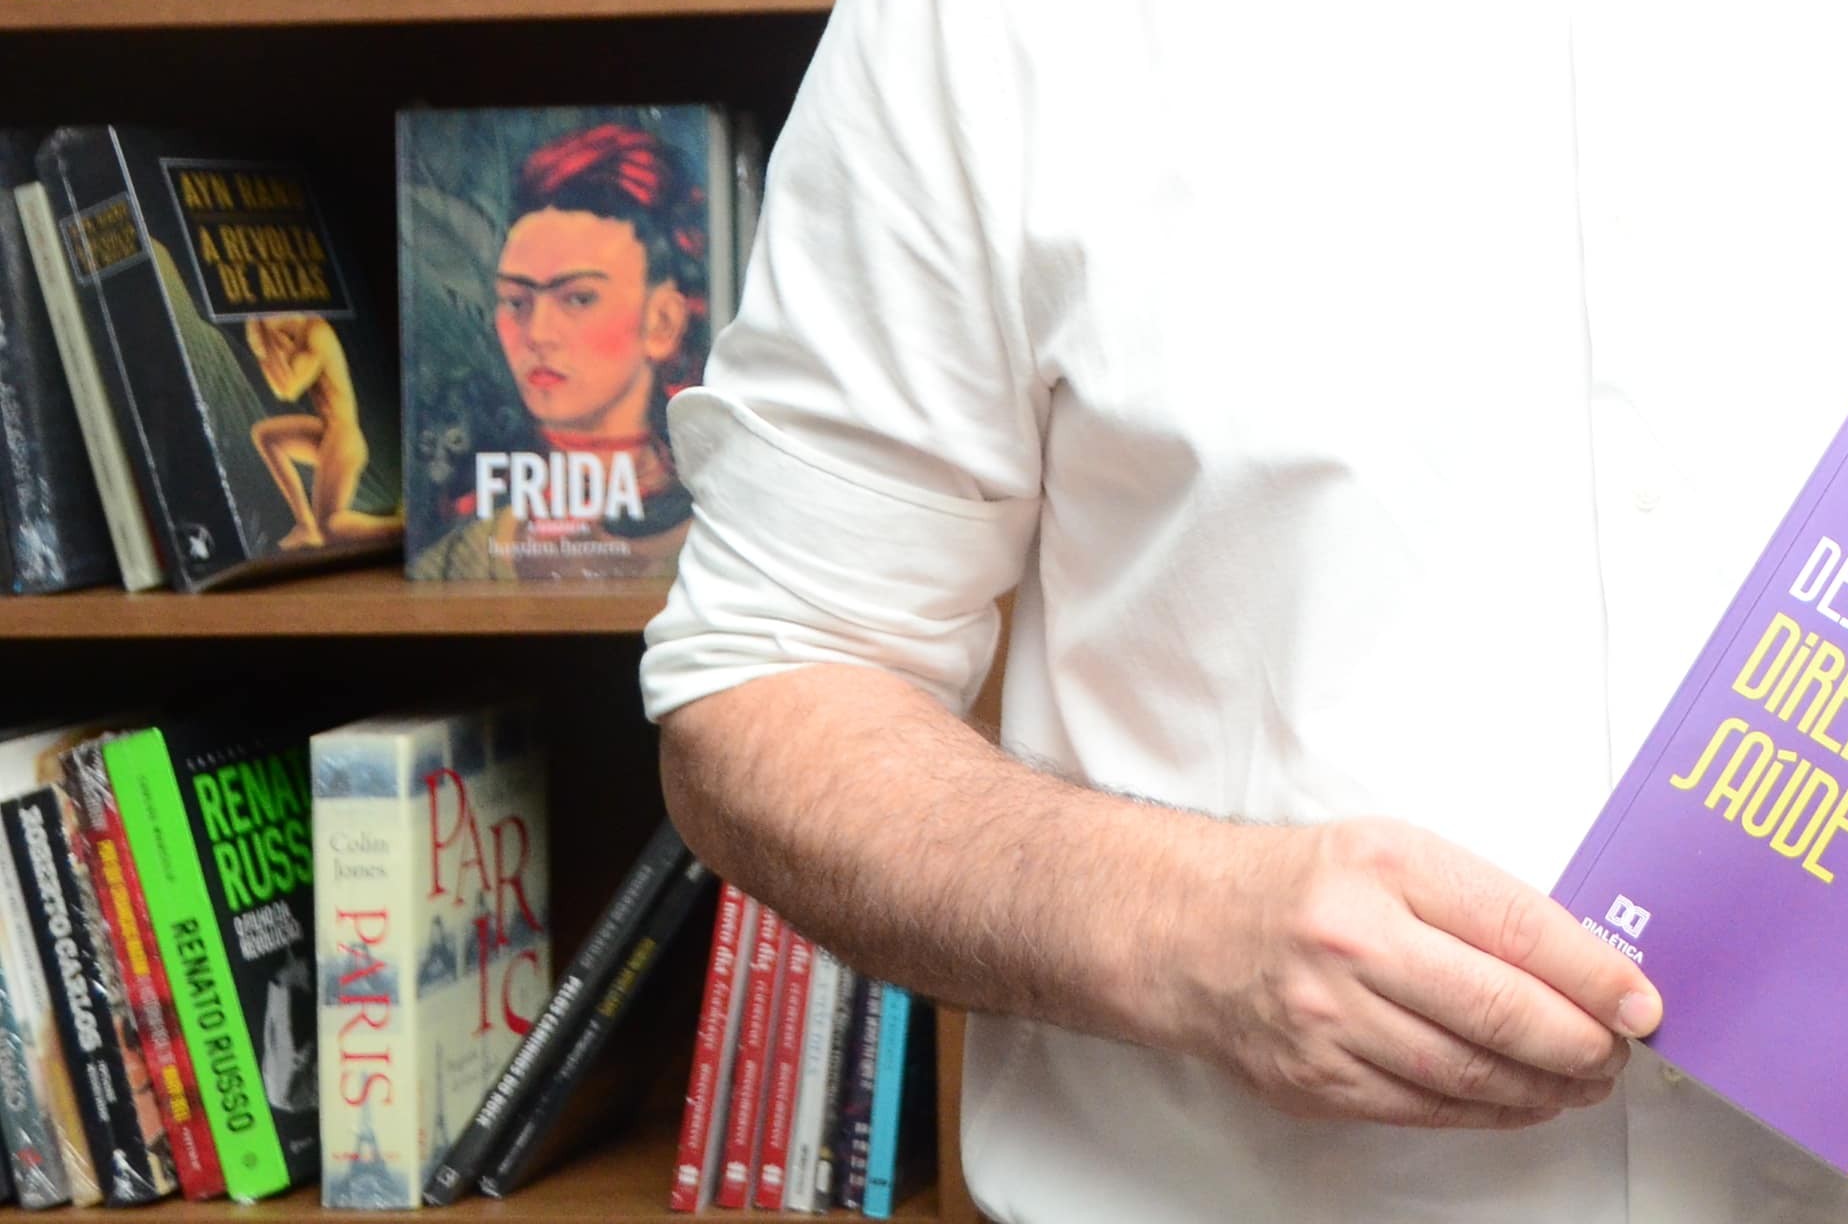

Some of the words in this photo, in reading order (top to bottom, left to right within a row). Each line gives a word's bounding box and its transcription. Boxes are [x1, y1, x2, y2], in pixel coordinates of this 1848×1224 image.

[180, 170, 235, 210] AYN
[199, 225, 222, 267] A
[220, 224, 329, 265] REVOLTA
[217, 262, 257, 305] DE
[257, 262, 333, 303] ATLAS
[475, 451, 645, 522] FRIDA
[212, 819, 314, 913] RUSS
[329, 831, 390, 856] Colin
[333, 857, 389, 880] Jones
[18, 806, 71, 936] ROBERTO
[52, 937, 102, 1052] CARLOS
[1581, 915, 1645, 965] DIALÉTICA
[335, 907, 393, 1109] PARIS
[545, 972, 585, 1017] PELOS
[170, 918, 226, 1032] RENATO
[205, 1034, 256, 1134] RUSSO
[501, 1009, 562, 1079] CAMINHOS
[494, 1071, 519, 1096] DO
[472, 1090, 508, 1129] ROCK
